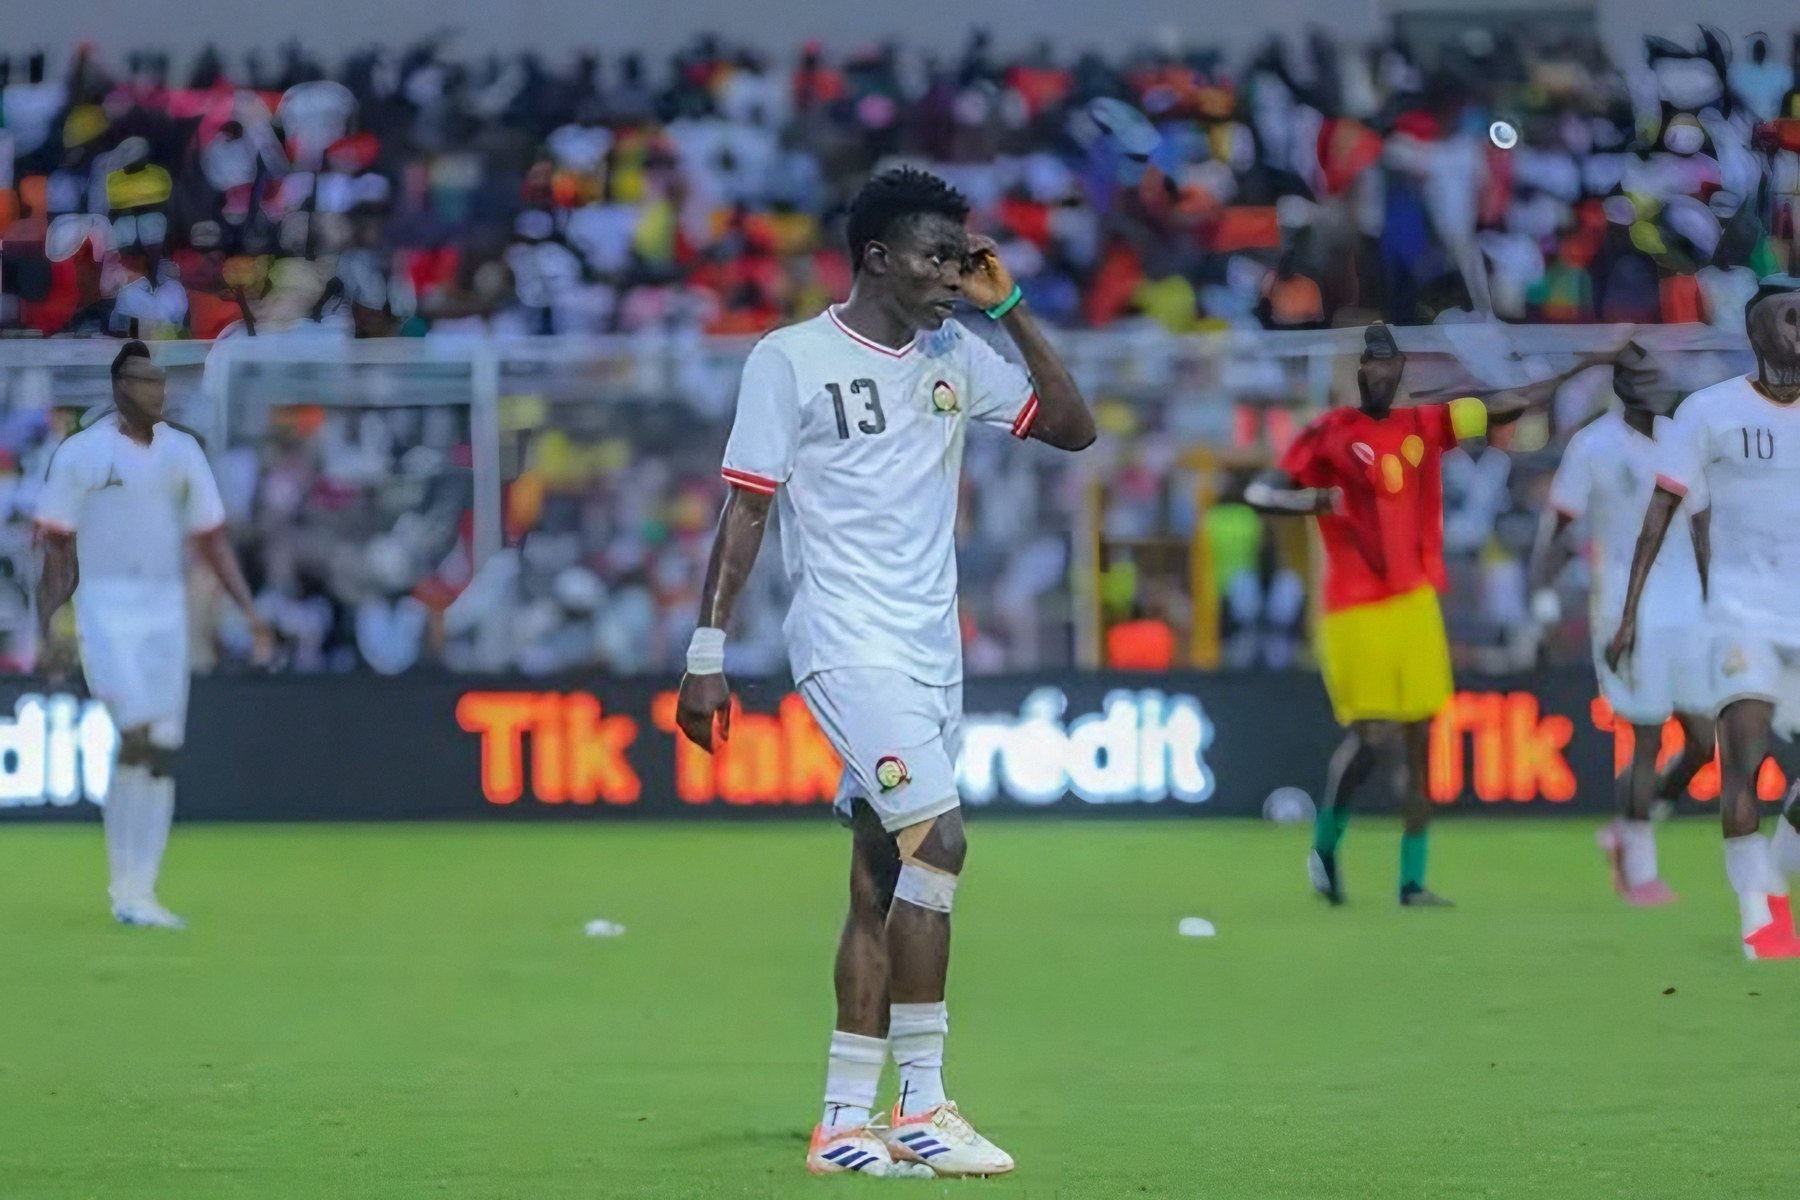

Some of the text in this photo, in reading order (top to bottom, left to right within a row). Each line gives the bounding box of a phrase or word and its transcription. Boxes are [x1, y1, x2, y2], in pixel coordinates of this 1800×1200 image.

[824, 378, 886, 440] 13
[1741, 427, 1774, 460] 10
[456, 691, 641, 804] Tik
[956, 687, 1215, 805] rédit
